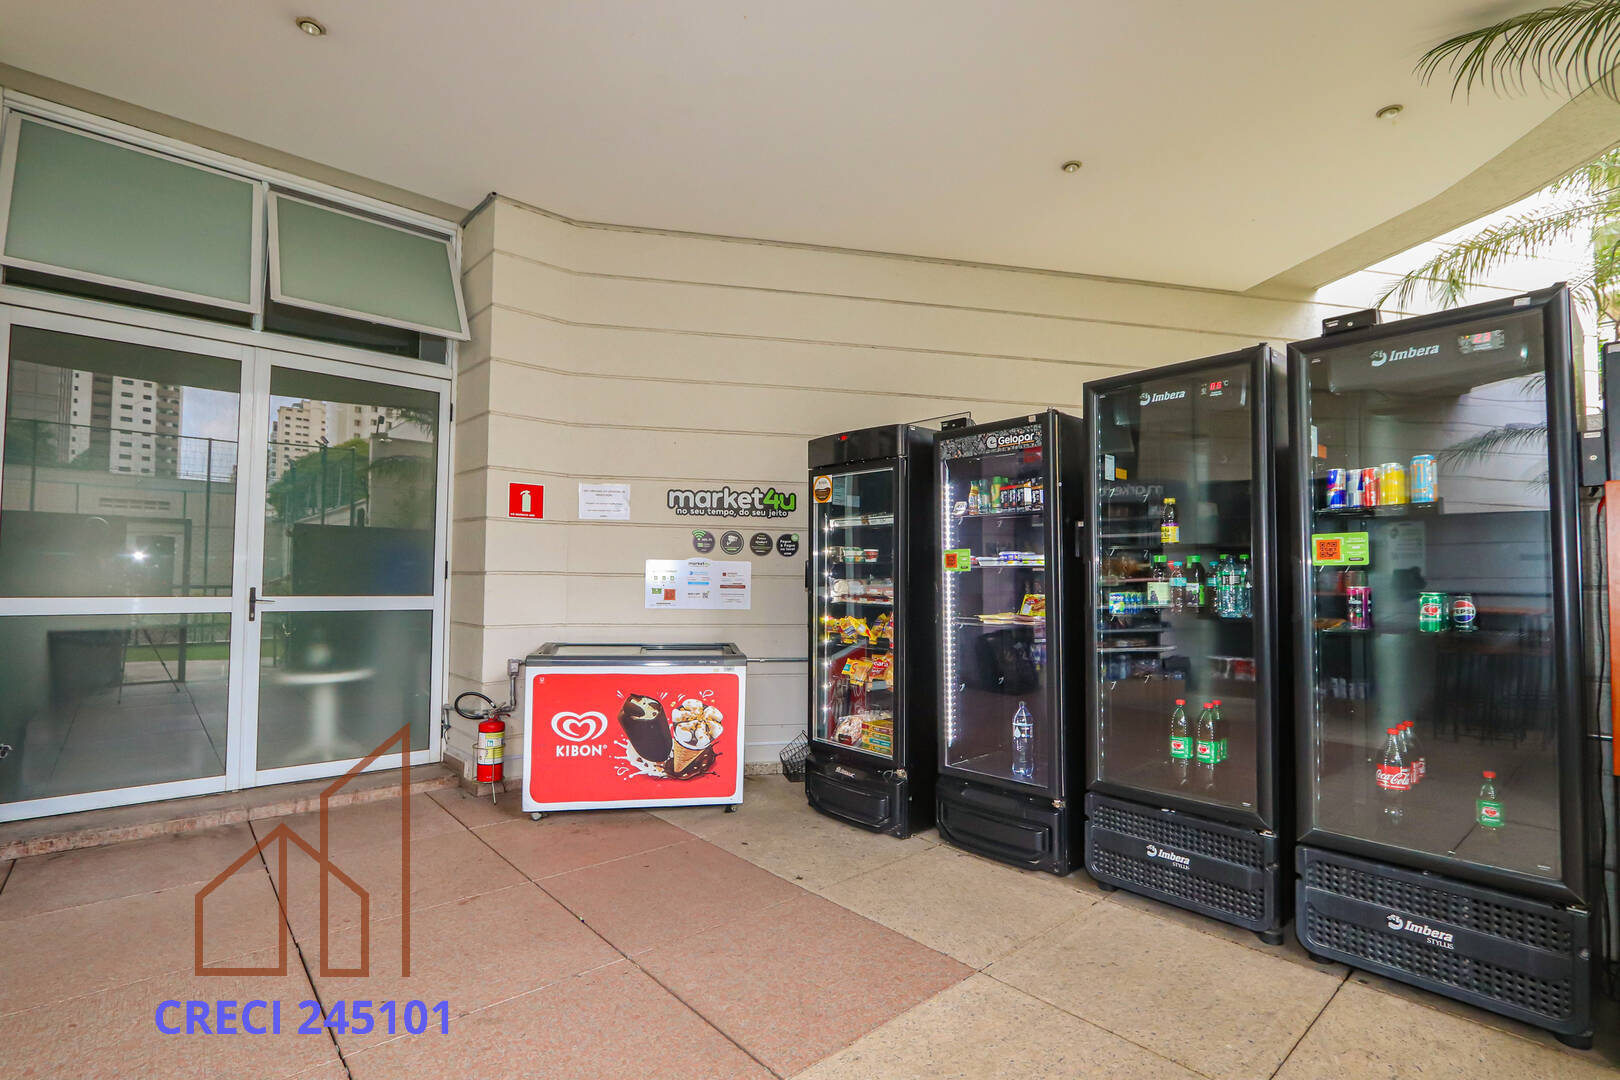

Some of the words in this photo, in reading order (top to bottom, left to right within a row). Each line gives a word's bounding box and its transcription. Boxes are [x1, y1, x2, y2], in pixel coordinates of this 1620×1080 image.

[1388, 344, 1440, 362] Imbera
[1151, 390, 1186, 402] Imbera
[998, 433, 1035, 446] Gelopar
[667, 487, 796, 510] market4u
[707, 508, 737, 517] tempo,
[767, 510, 788, 518] jeito
[556, 744, 602, 757] KIBON
[1157, 849, 1190, 865] Imbera
[1404, 920, 1454, 943] Imbera
[1426, 937, 1455, 950] STYLUS
